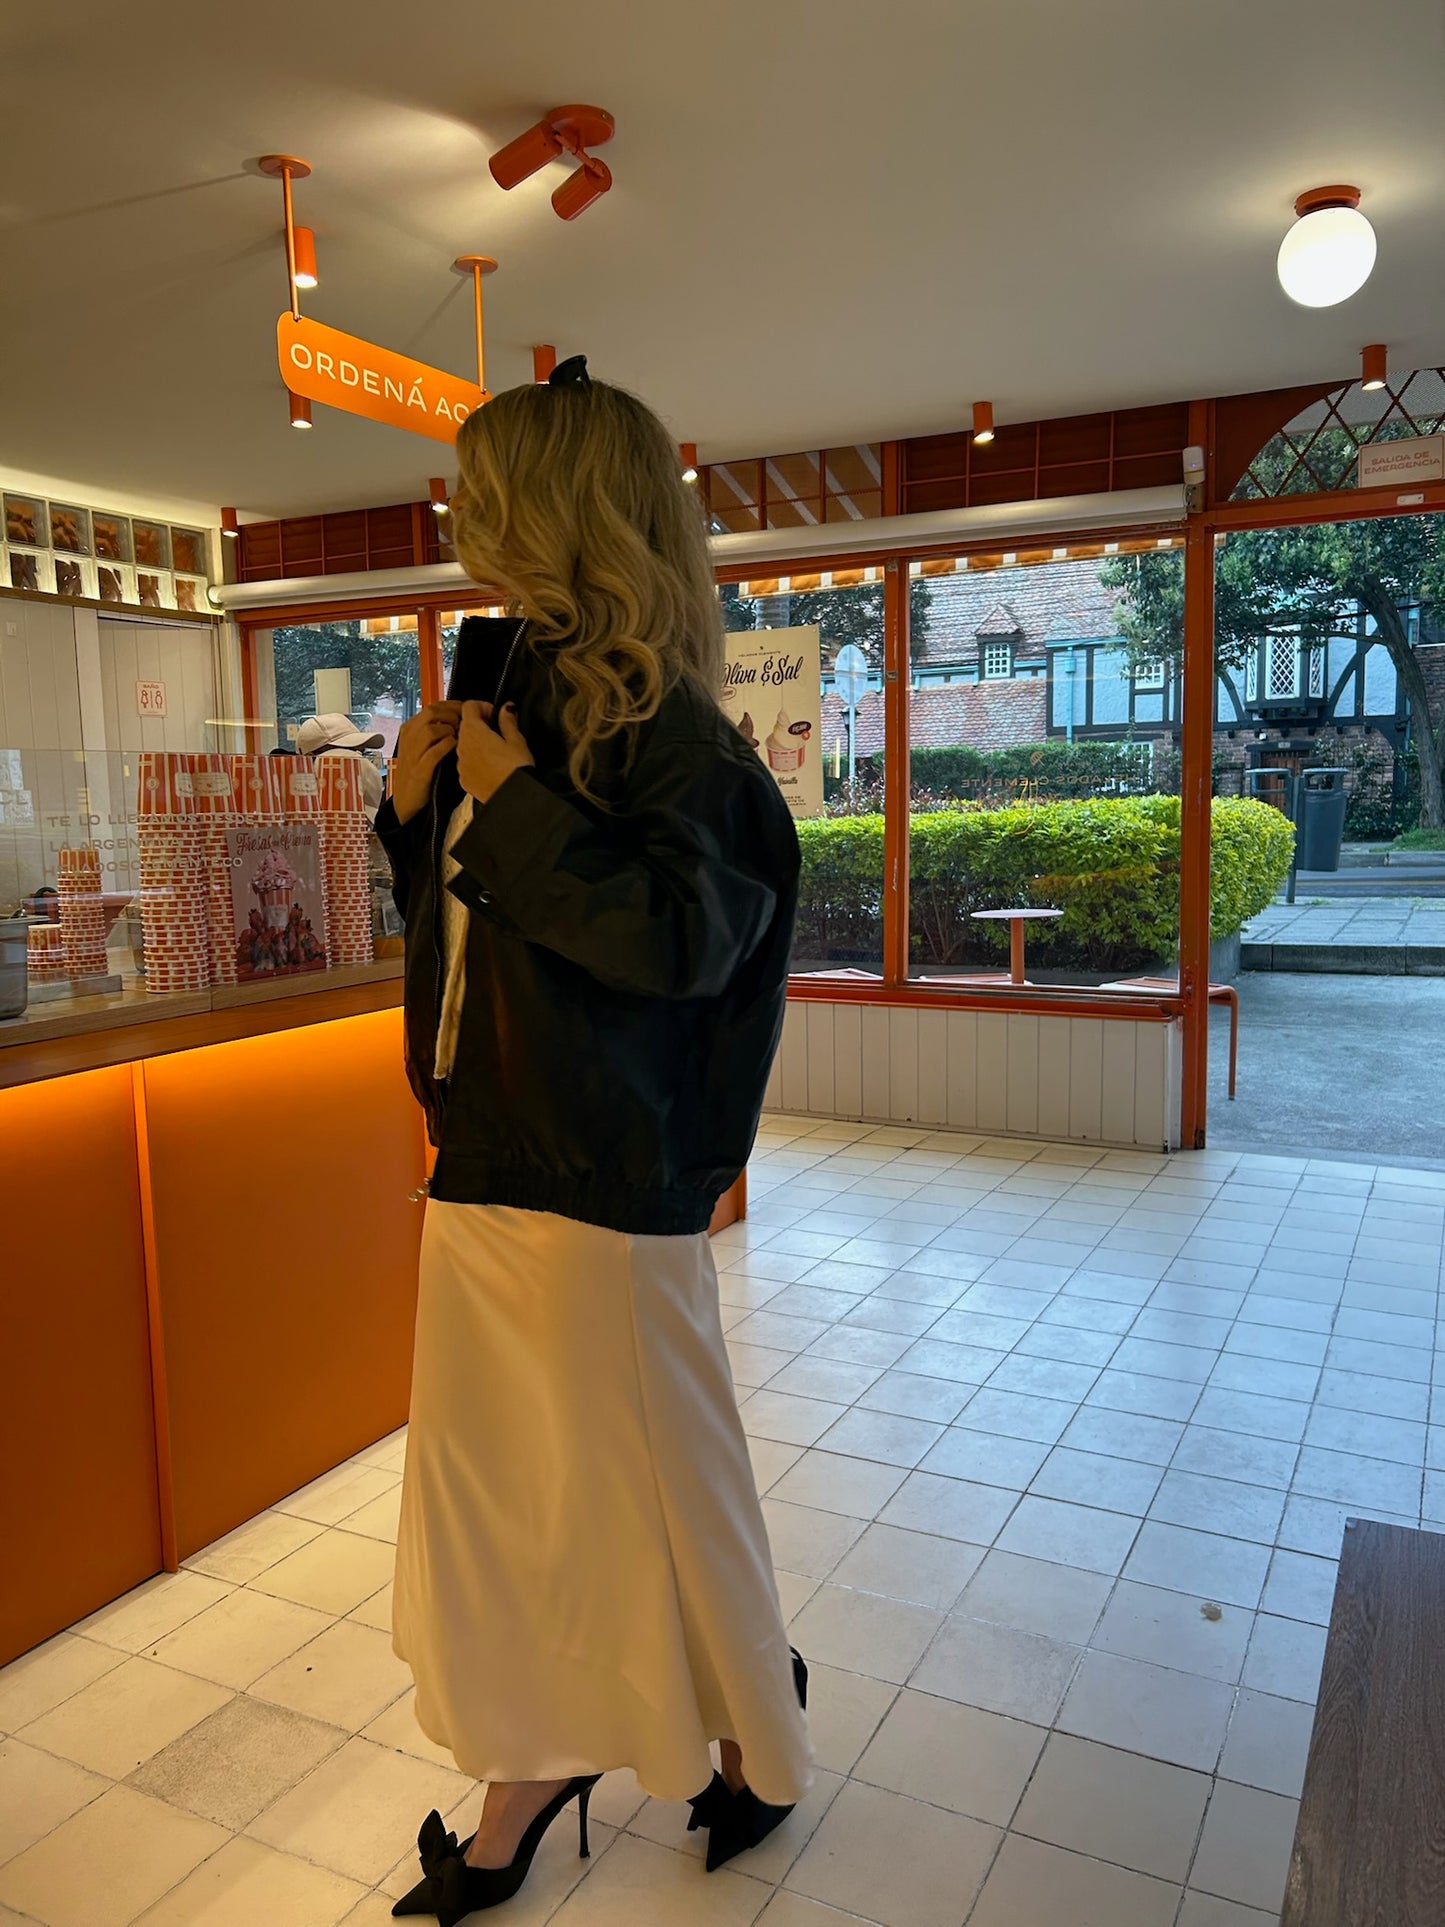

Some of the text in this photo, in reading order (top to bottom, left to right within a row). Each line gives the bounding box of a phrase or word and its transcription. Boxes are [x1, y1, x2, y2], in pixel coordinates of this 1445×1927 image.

[290, 342, 427, 413] ORDENÁ
[1371, 450, 1430, 466] SALIDA DE
[1364, 458, 1441, 475] EMERGENCIA
[772, 654, 804, 686] Sal
[47, 815, 71, 828] TE
[79, 814, 101, 826] LO
[203, 813, 254, 825] DESDE
[50, 840, 72, 853] LA
